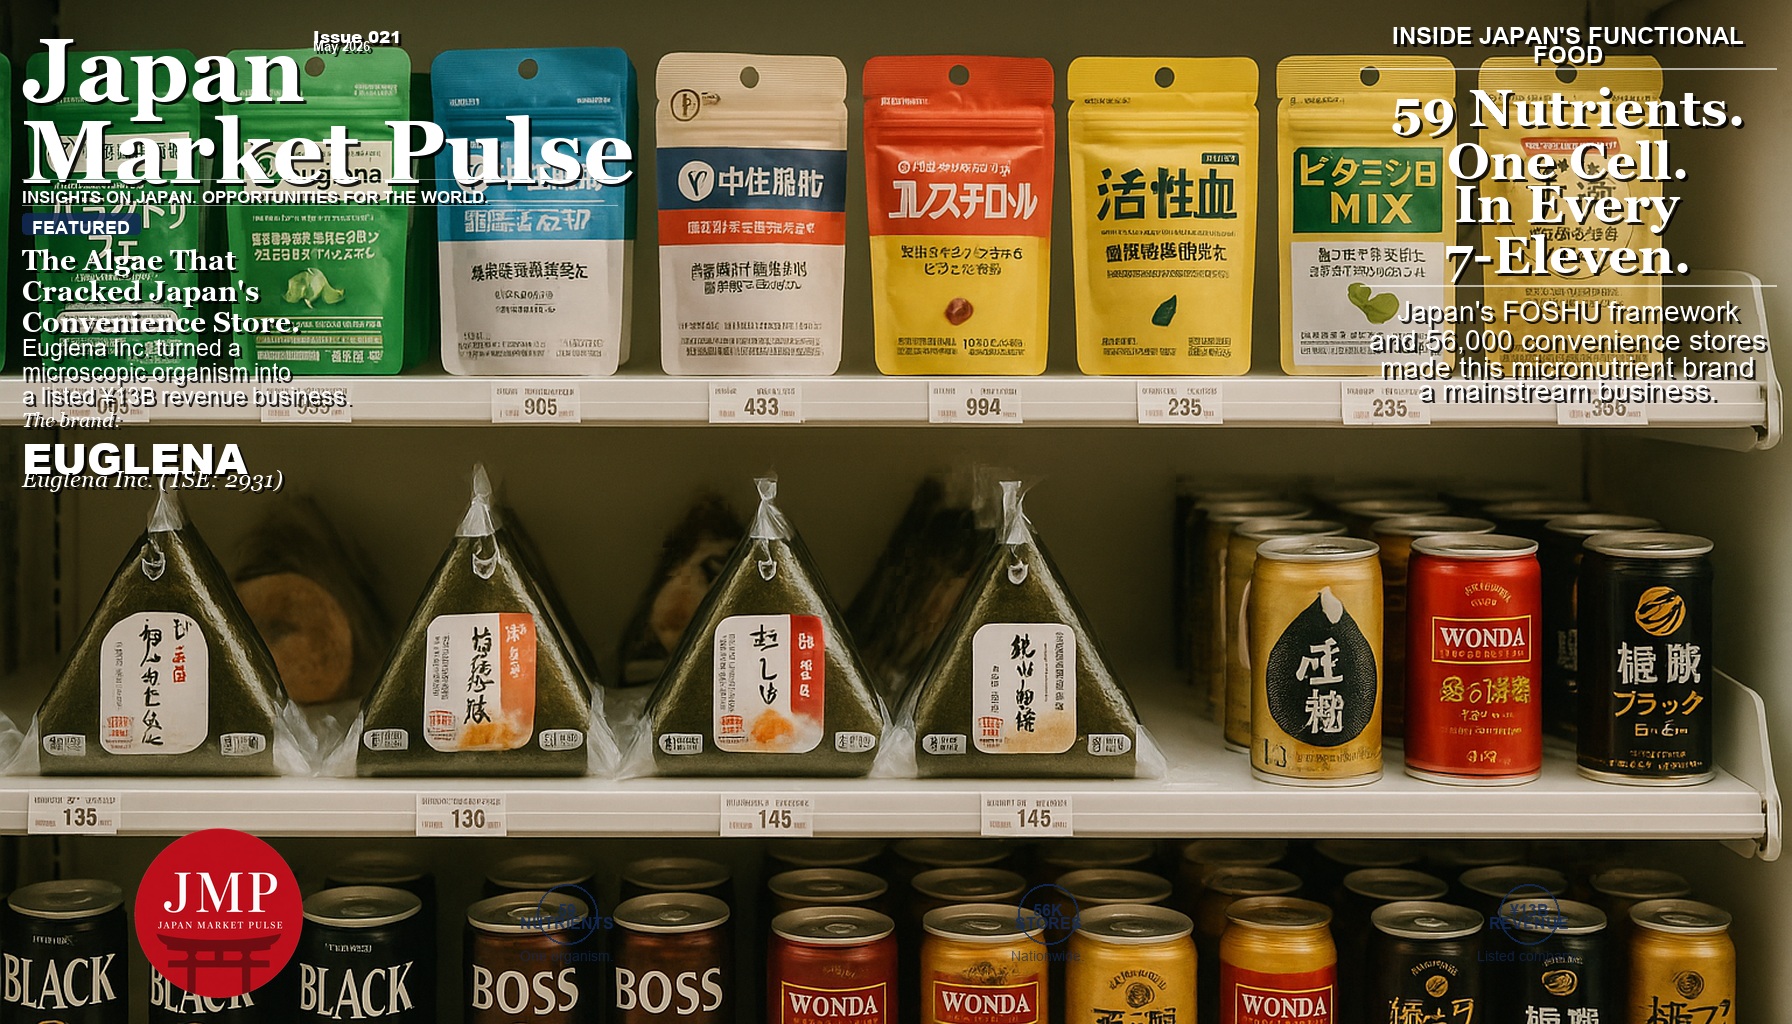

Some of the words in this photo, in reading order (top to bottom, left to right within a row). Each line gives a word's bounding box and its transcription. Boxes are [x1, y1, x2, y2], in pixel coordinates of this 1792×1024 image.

[1330, 192, 1413, 224] MIX
[524, 397, 557, 416] 905
[744, 397, 779, 416] 433
[966, 398, 1002, 416] 994
[1168, 398, 1202, 417] 235
[1372, 398, 1407, 418] 235
[1440, 626, 1526, 648] WONDA
[63, 807, 98, 826] 135
[451, 809, 485, 828] 130
[758, 809, 792, 828] 145
[1017, 809, 1051, 828] 145
[3, 952, 117, 1010] BLACK
[300, 960, 415, 1020] BLACK
[472, 964, 580, 1015] BOSS
[615, 966, 723, 1016] BOSS
[788, 992, 879, 1017] WONDA
[941, 990, 1031, 1014] WONDA
[1242, 992, 1328, 1018] WONDA
